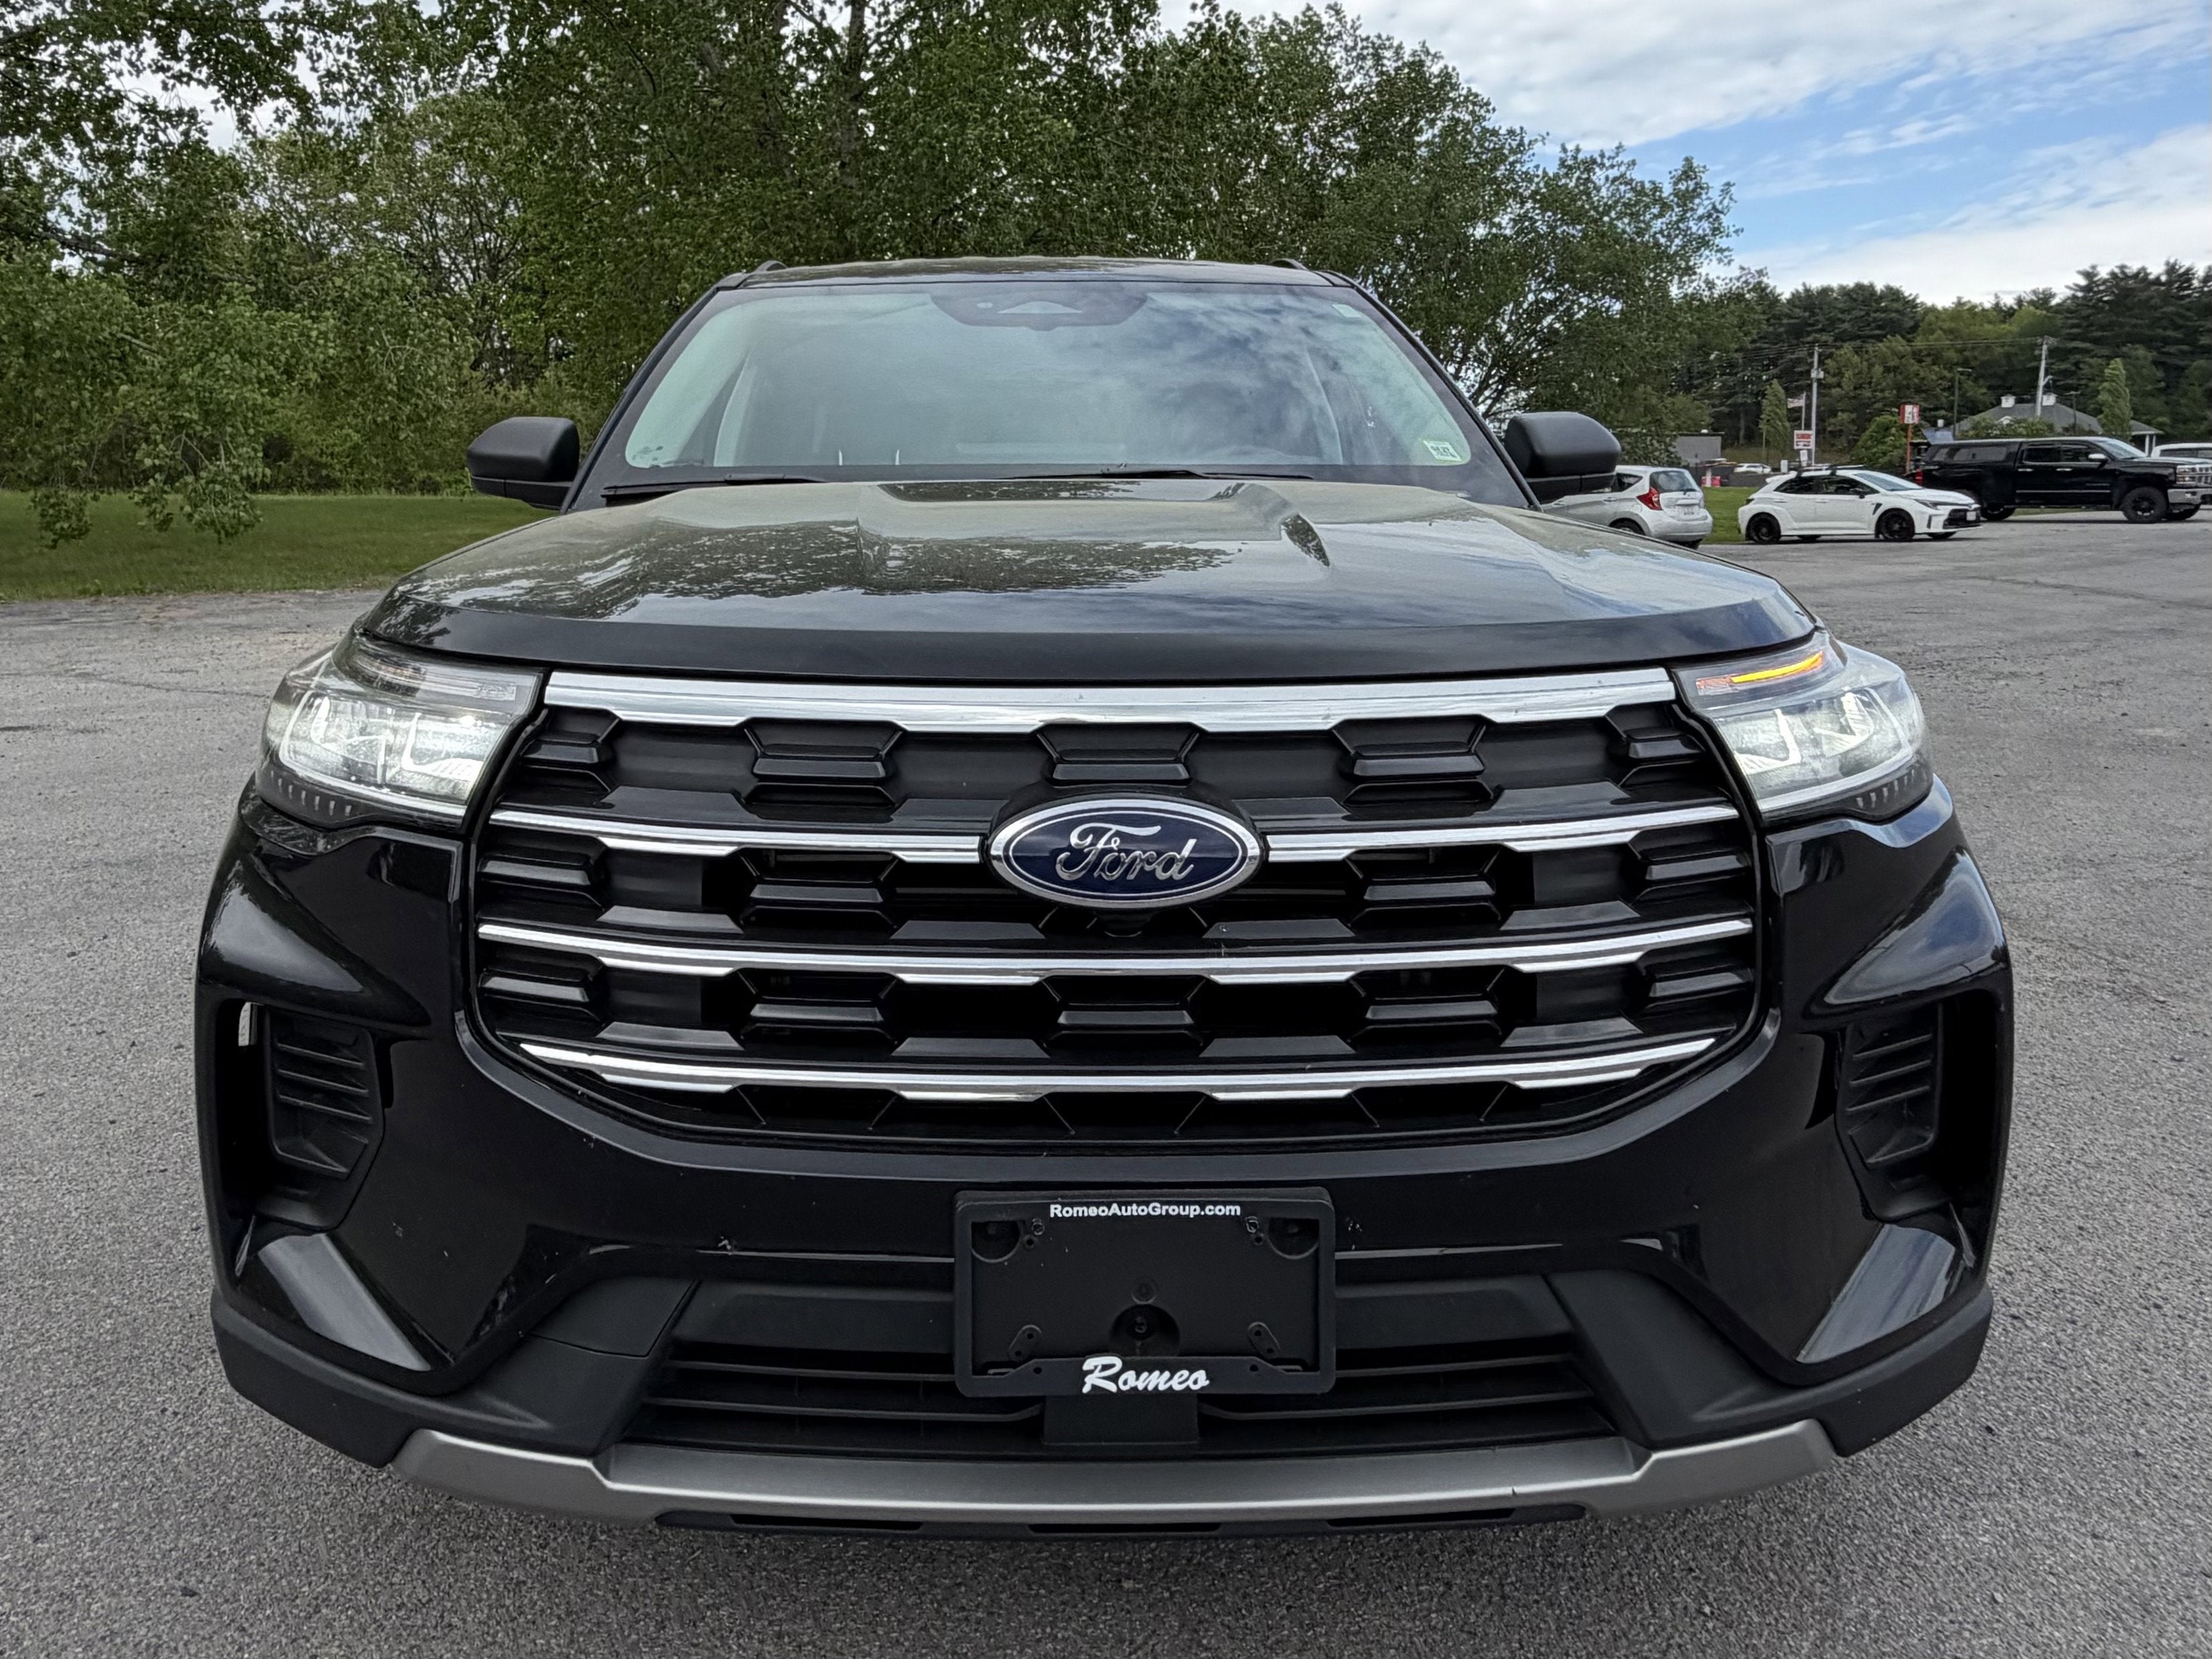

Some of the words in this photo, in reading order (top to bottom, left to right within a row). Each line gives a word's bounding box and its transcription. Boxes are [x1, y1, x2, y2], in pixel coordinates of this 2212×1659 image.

[1056, 823, 1197, 880] Ford
[1050, 1203, 1240, 1218] RomeoAutoGroup.com
[1082, 1356, 1209, 1393] Romeo
